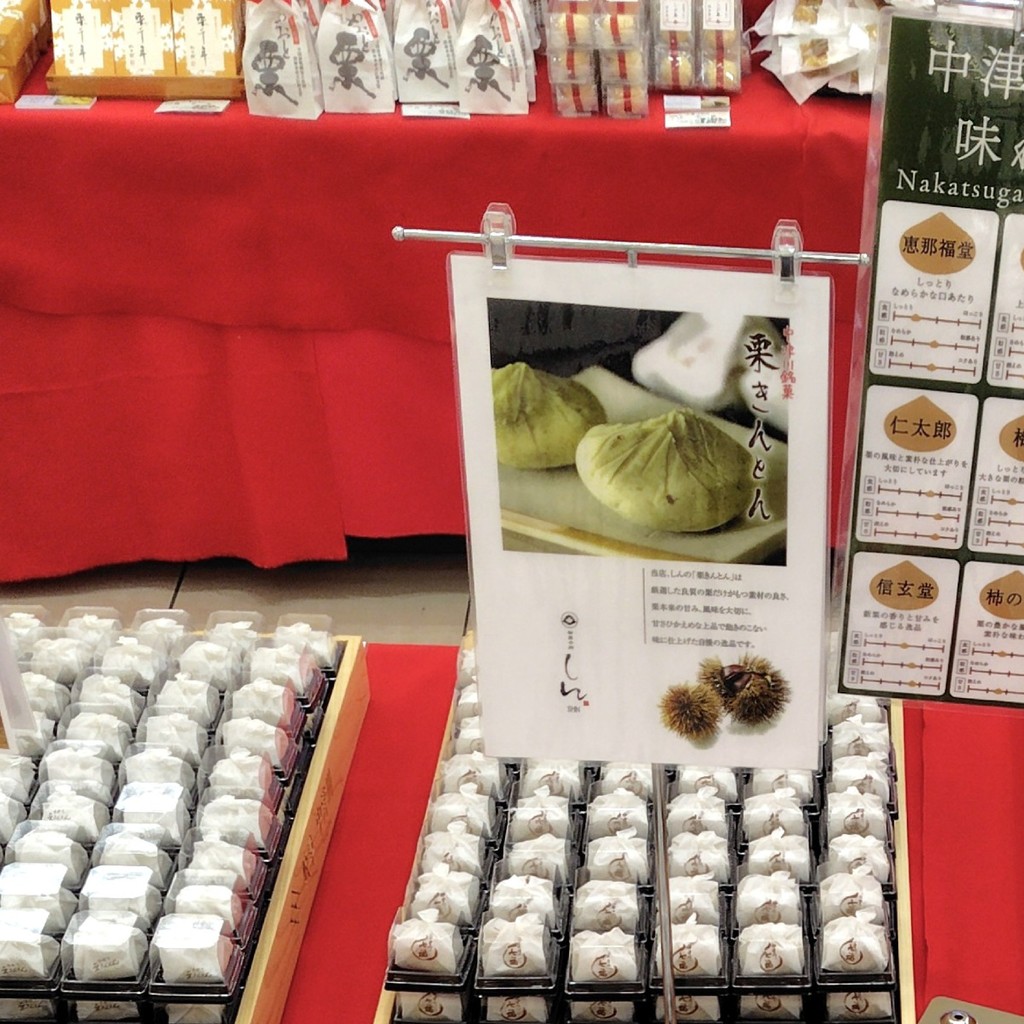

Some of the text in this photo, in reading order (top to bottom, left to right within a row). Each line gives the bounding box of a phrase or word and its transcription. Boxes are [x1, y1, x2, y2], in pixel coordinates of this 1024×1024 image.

[903, 235, 974, 260] 恵那福堂
[891, 287, 975, 304] なめらかな口あたり
[917, 277, 952, 289] しっとり
[780, 324, 796, 400] 中津川銘菓
[743, 332, 780, 521] 栗きんとん
[890, 415, 952, 440] 仁太郎
[884, 464, 947, 477] 大切にしています
[876, 577, 935, 600] 信玄堂
[560, 653, 587, 701] しん
